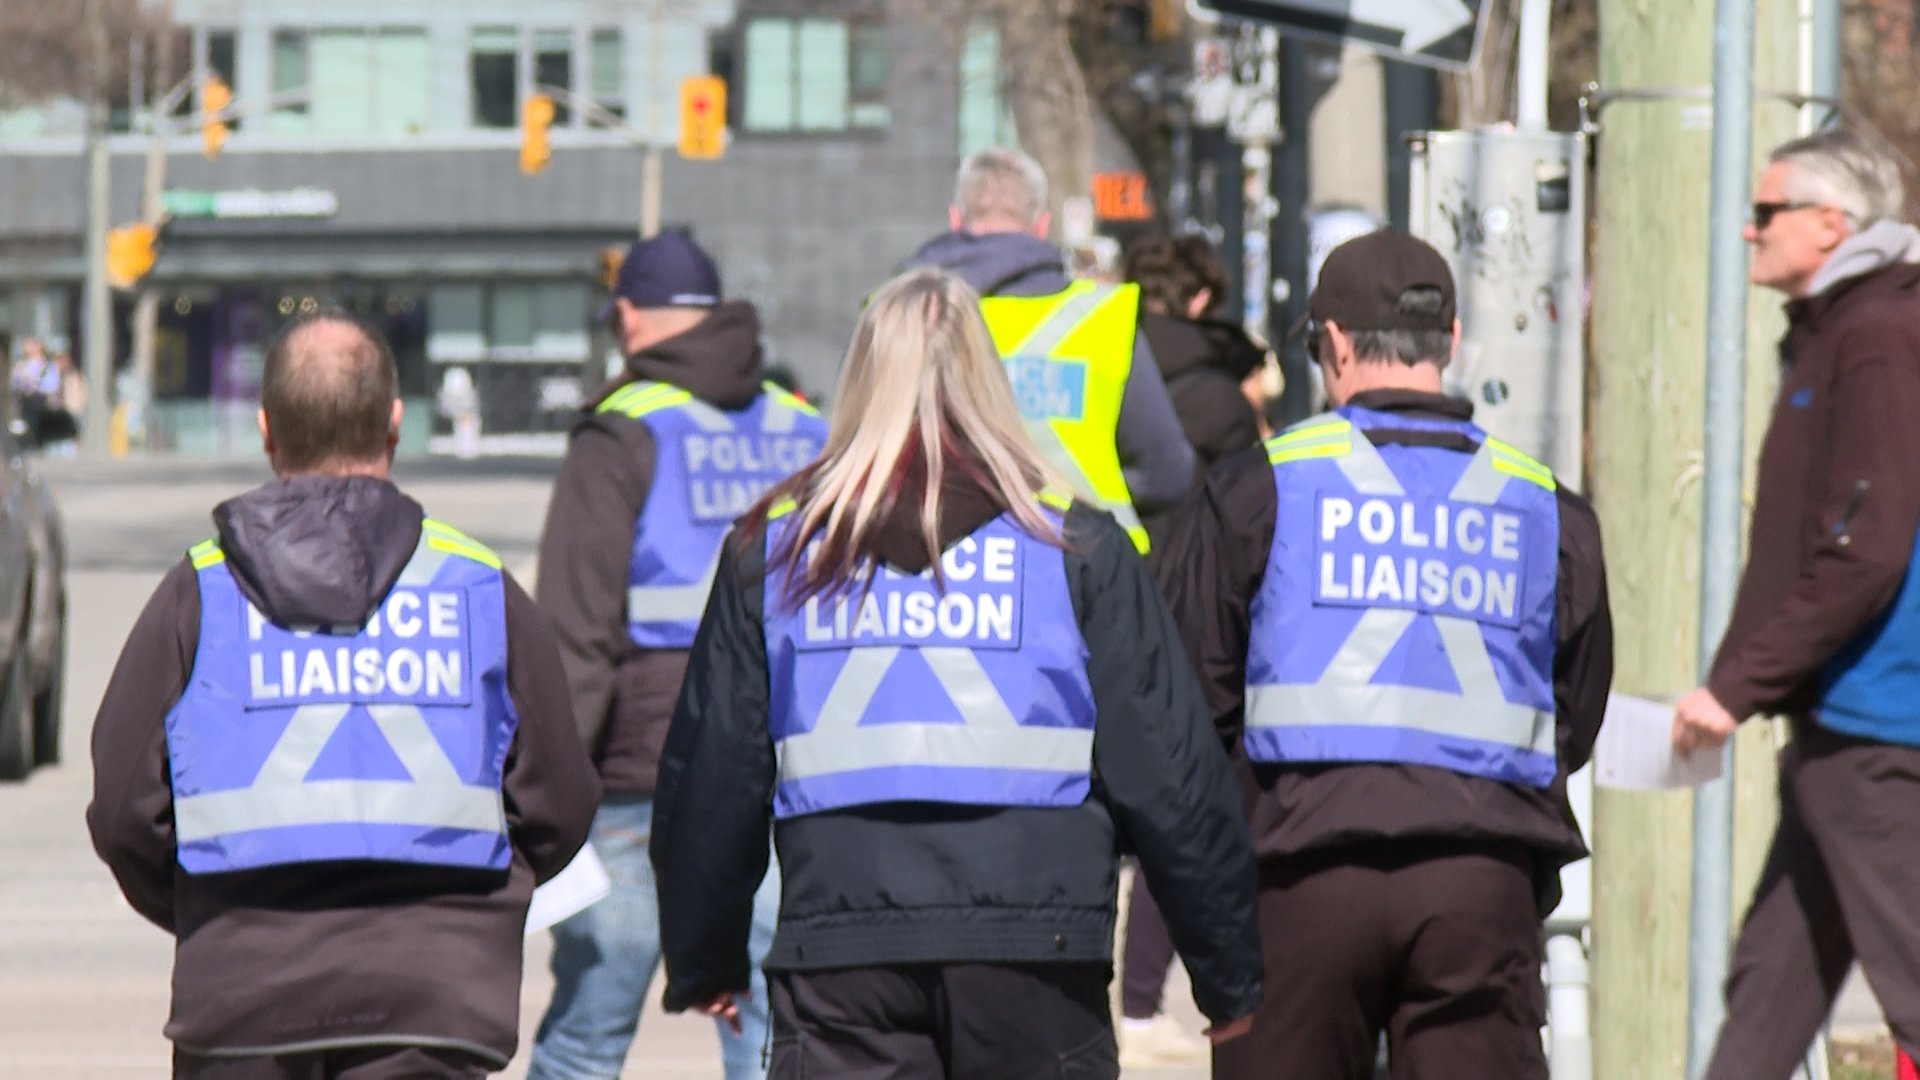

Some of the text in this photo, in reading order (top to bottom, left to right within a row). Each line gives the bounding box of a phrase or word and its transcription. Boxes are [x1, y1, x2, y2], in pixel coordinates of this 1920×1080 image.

[1321, 497, 1520, 560] POLICE
[1319, 551, 1517, 619] LIAISON
[247, 590, 460, 640] PCE
[804, 591, 1014, 641] LIAISON
[250, 647, 461, 698] LIAISON
